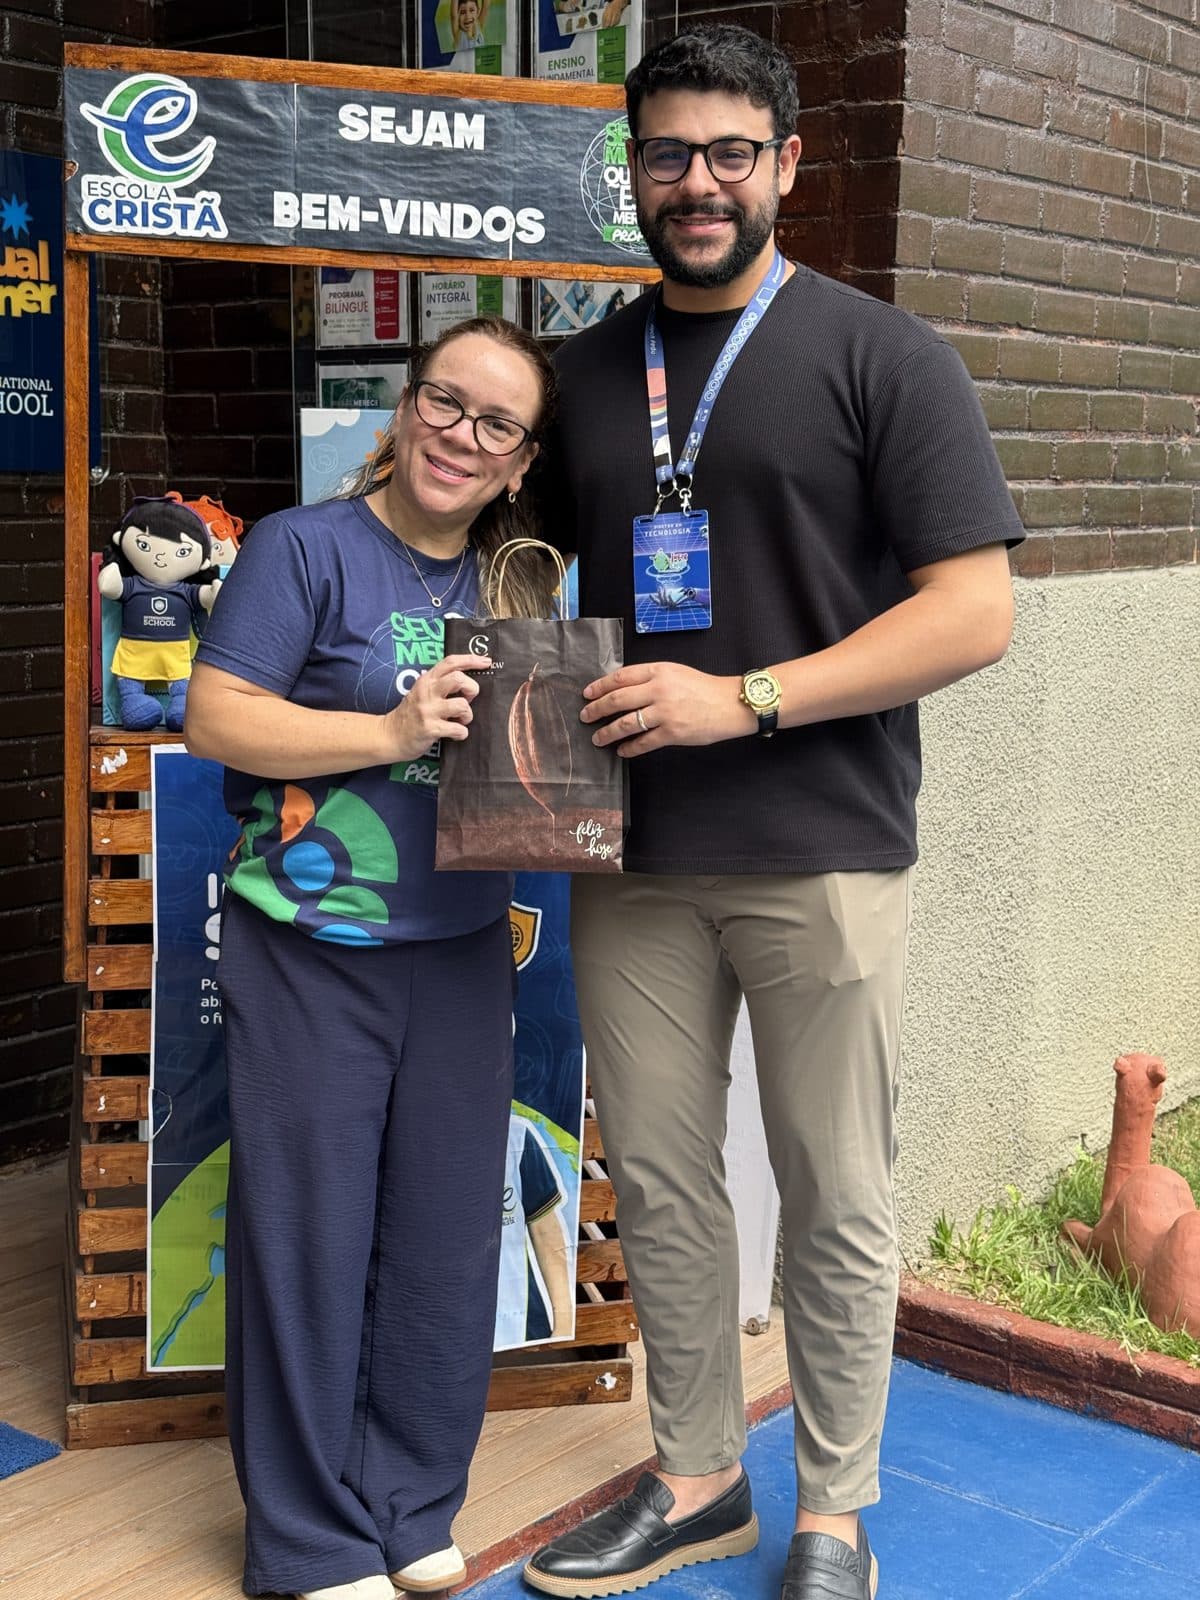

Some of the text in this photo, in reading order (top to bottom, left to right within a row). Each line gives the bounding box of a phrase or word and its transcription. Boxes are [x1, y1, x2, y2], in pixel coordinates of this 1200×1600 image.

[548, 56, 586, 71] ENSINO
[338, 104, 486, 150] SEJAM
[87, 181, 171, 200] ESCOLA
[88, 197, 221, 232] CRISTÃ
[273, 190, 545, 244] BEM-VINDOS
[432, 280, 466, 291] HORÁRIO
[329, 290, 365, 299] PROGRAMA
[426, 291, 471, 304] INTEGRAL
[645, 527, 691, 537] TECNOLOGIA
[143, 619, 176, 627] SCHOOL
[569, 818, 606, 844] feliz
[584, 837, 613, 860] hoje
